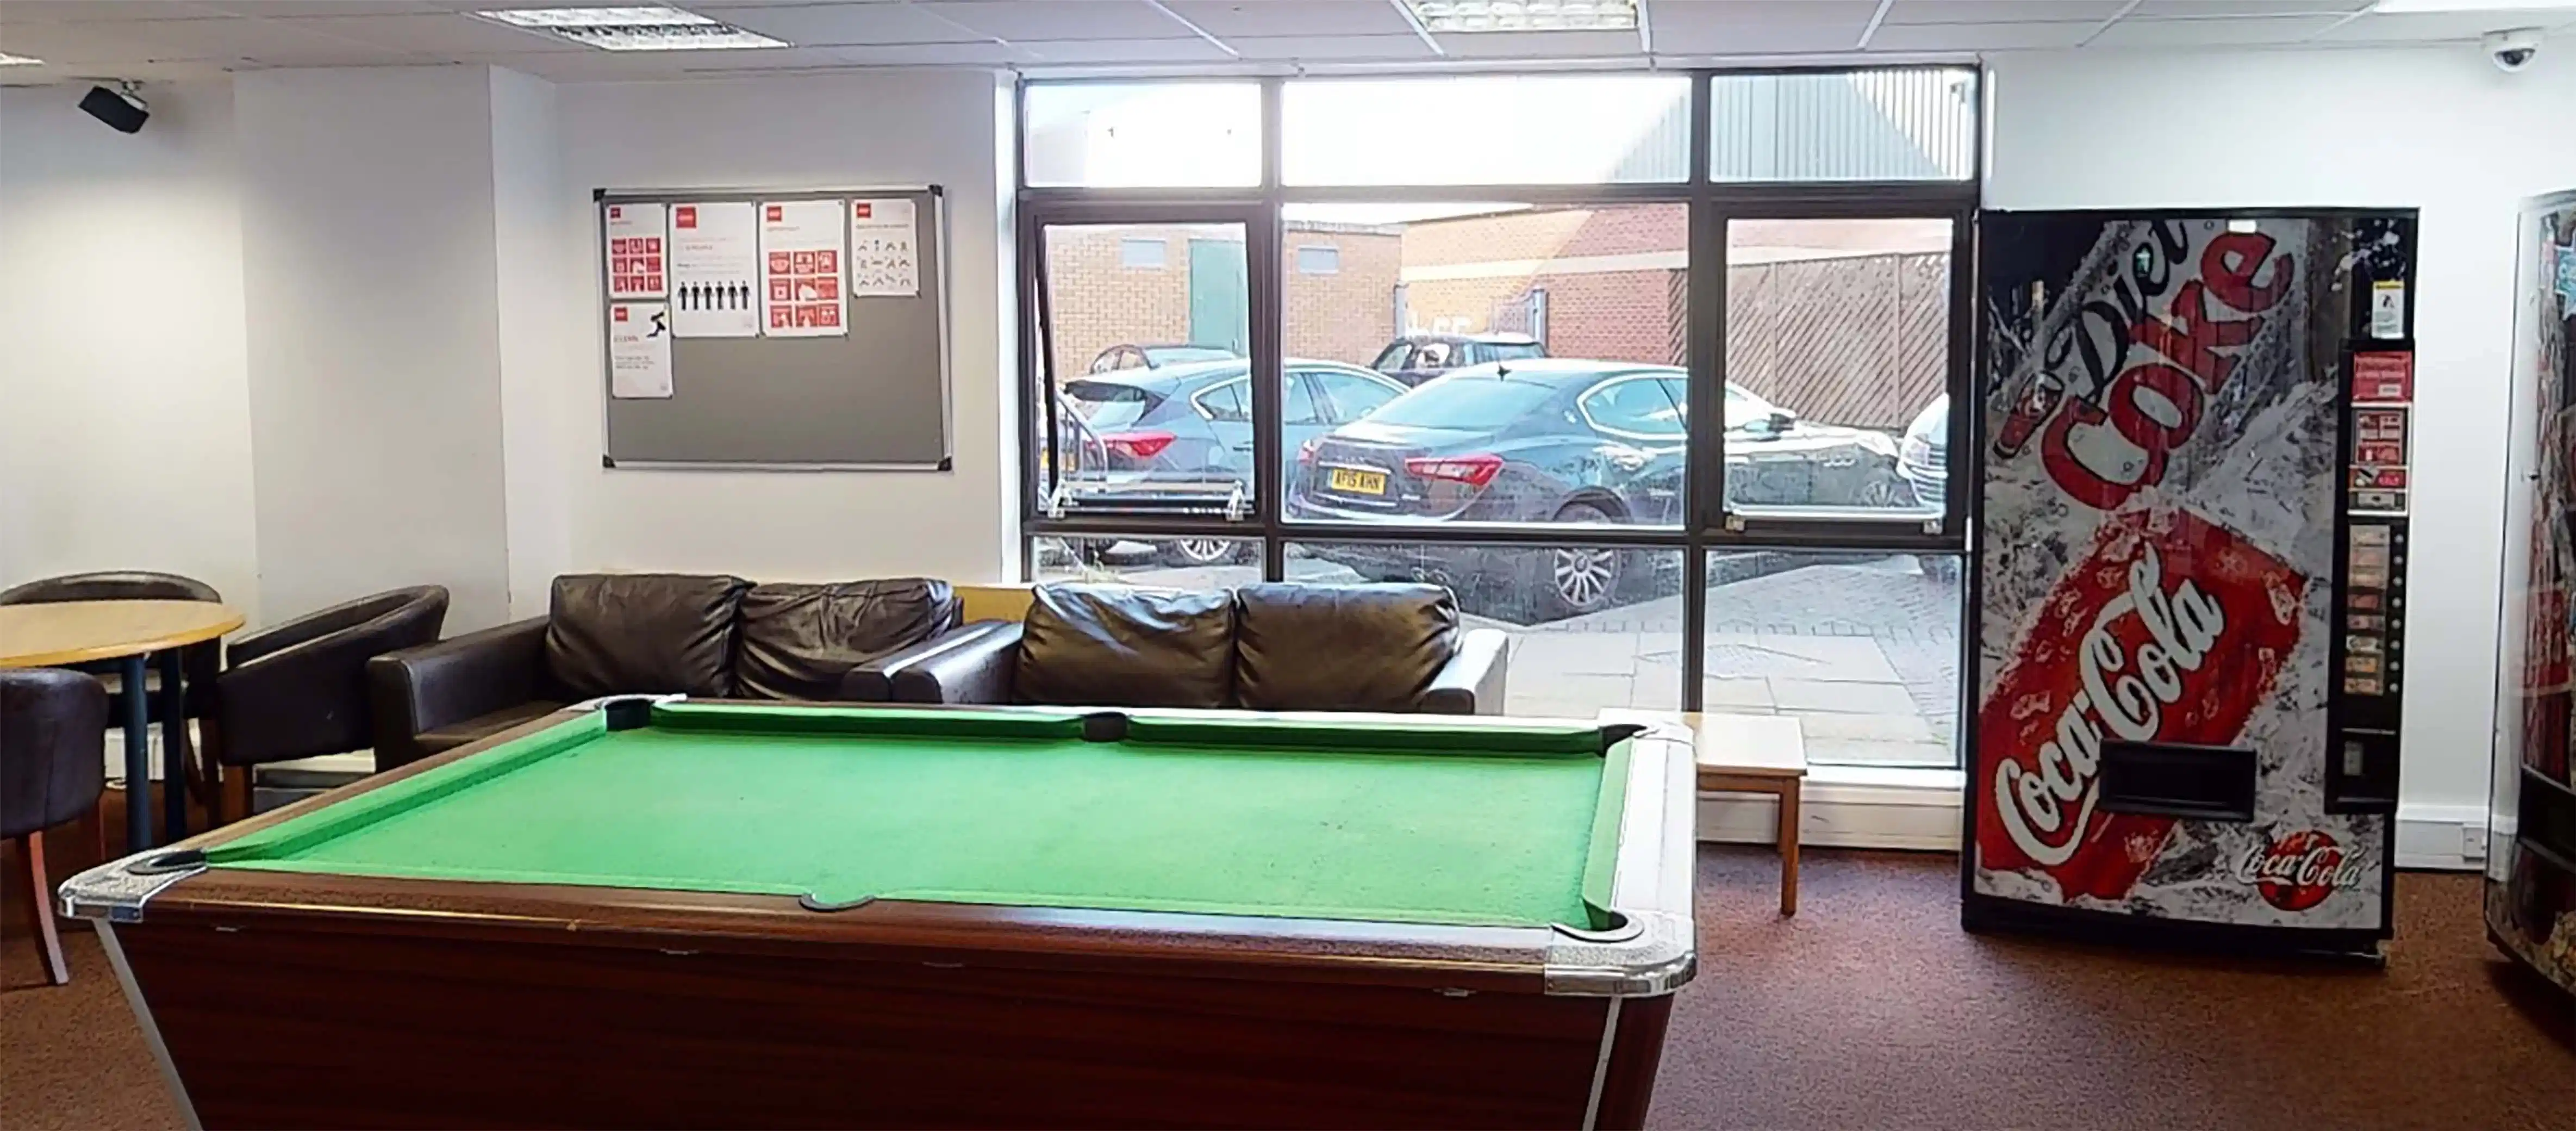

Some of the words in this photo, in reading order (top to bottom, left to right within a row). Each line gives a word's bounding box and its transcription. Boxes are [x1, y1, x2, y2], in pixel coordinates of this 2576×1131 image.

[2041, 231, 2294, 510] Coke
[1995, 542, 2225, 866] Coca-Cola
[2236, 844, 2366, 887] Coca-Cola
